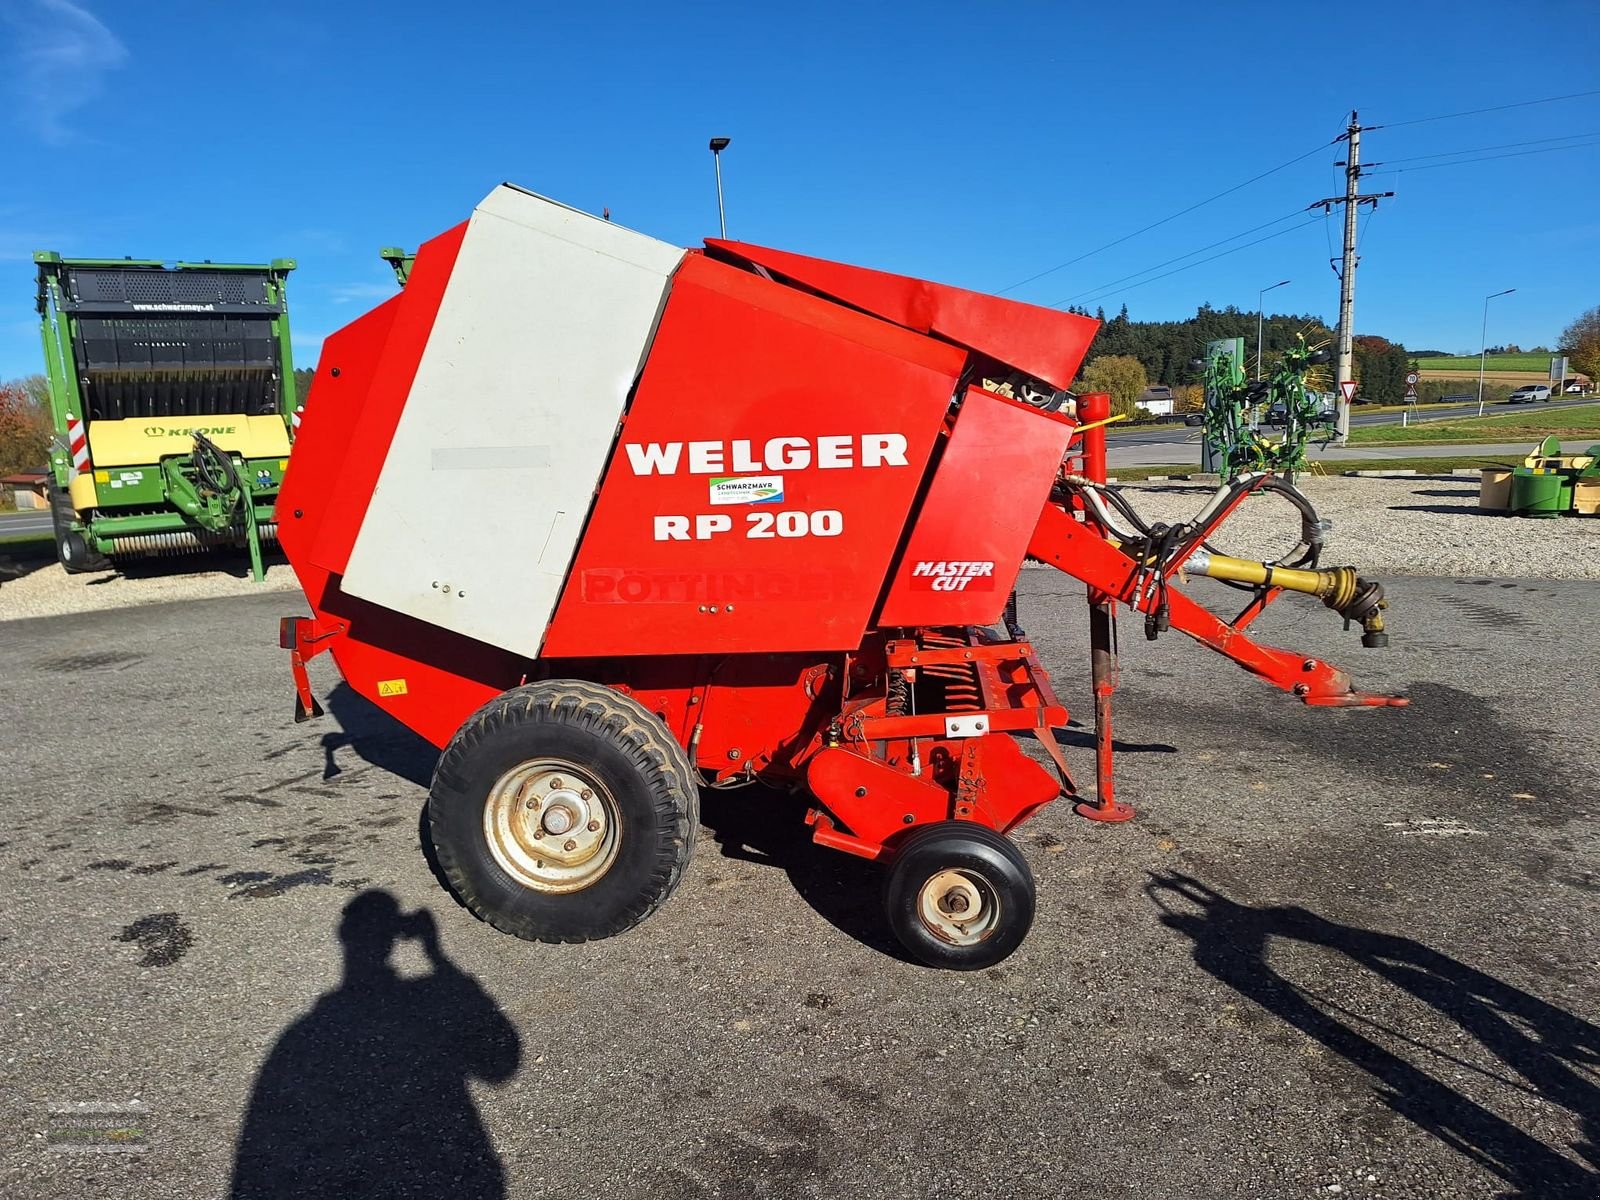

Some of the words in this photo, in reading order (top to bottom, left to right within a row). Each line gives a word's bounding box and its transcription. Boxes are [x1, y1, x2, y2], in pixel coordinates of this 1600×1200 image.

[132, 303, 214, 312] www.schwarzmayr.at
[168, 427, 236, 436] KRONE
[625, 433, 909, 476] WELGER
[716, 482, 773, 490] SCHWARZMAYR
[653, 514, 732, 541] RP
[746, 510, 843, 538] 200
[912, 561, 995, 576] MASTER
[931, 576, 973, 591] CUT
